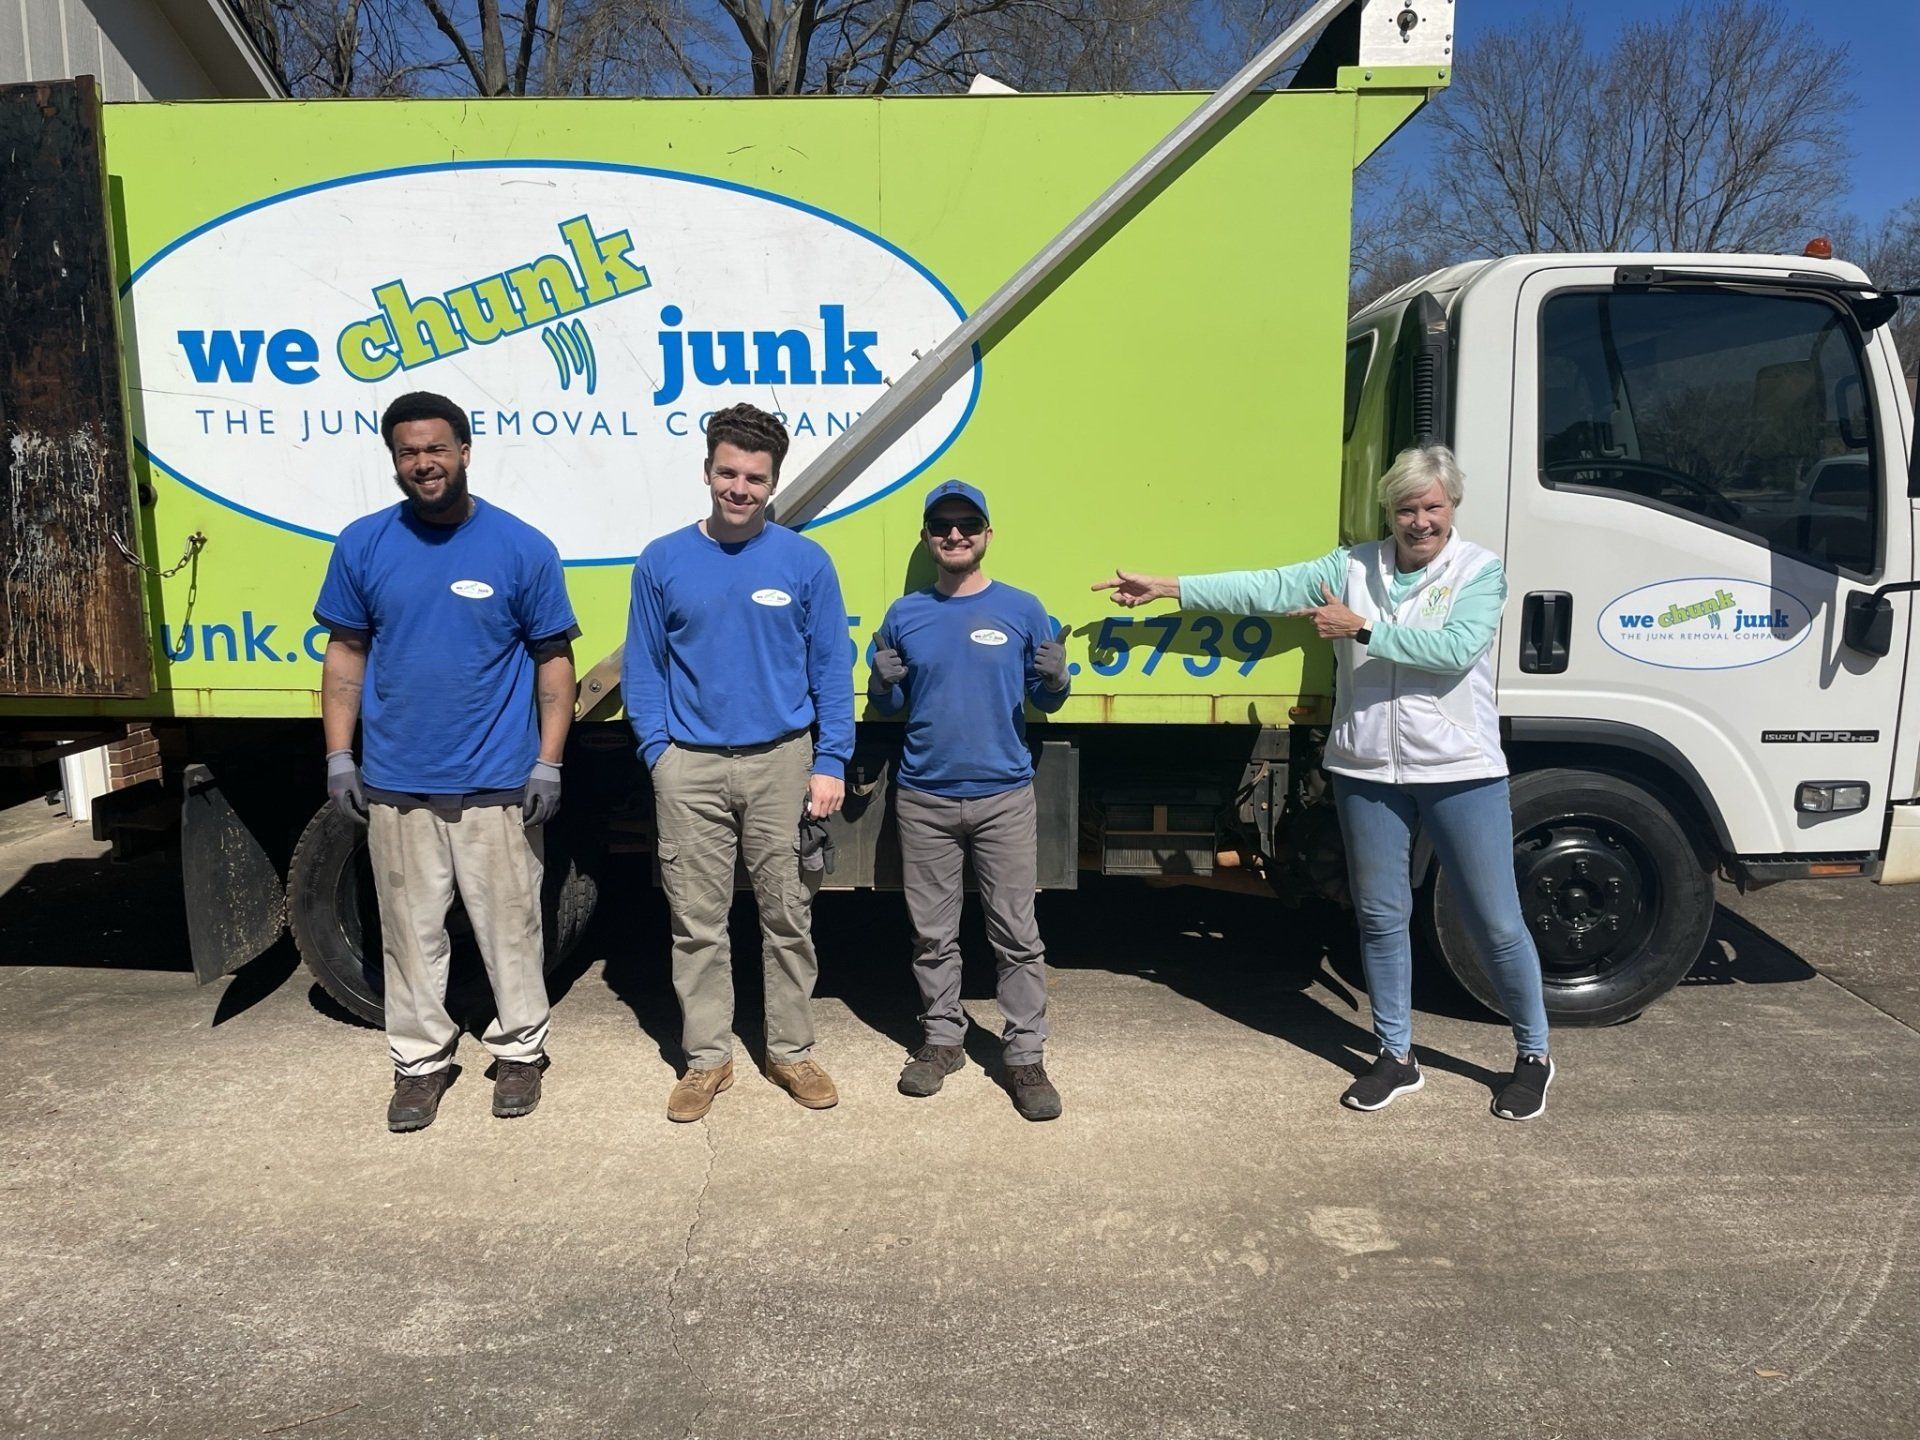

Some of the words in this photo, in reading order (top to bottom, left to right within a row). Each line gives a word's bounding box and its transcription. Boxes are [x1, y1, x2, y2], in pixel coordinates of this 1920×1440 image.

[178, 330, 320, 384] we
[335, 214, 652, 383] chunk
[654, 305, 883, 406] junk
[195, 410, 275, 435] THE
[301, 410, 379, 442] JUN
[470, 410, 638, 436] EMOVAL
[1619, 614, 1654, 628] we
[1658, 589, 1737, 628] chunk
[1733, 609, 1790, 632] junk
[160, 611, 332, 663] unk.c
[1646, 633, 1675, 642] JUNK
[1680, 633, 1729, 641] REMOVAL
[1735, 633, 1787, 641] COMPANY
[1796, 731, 1852, 742] NPR
